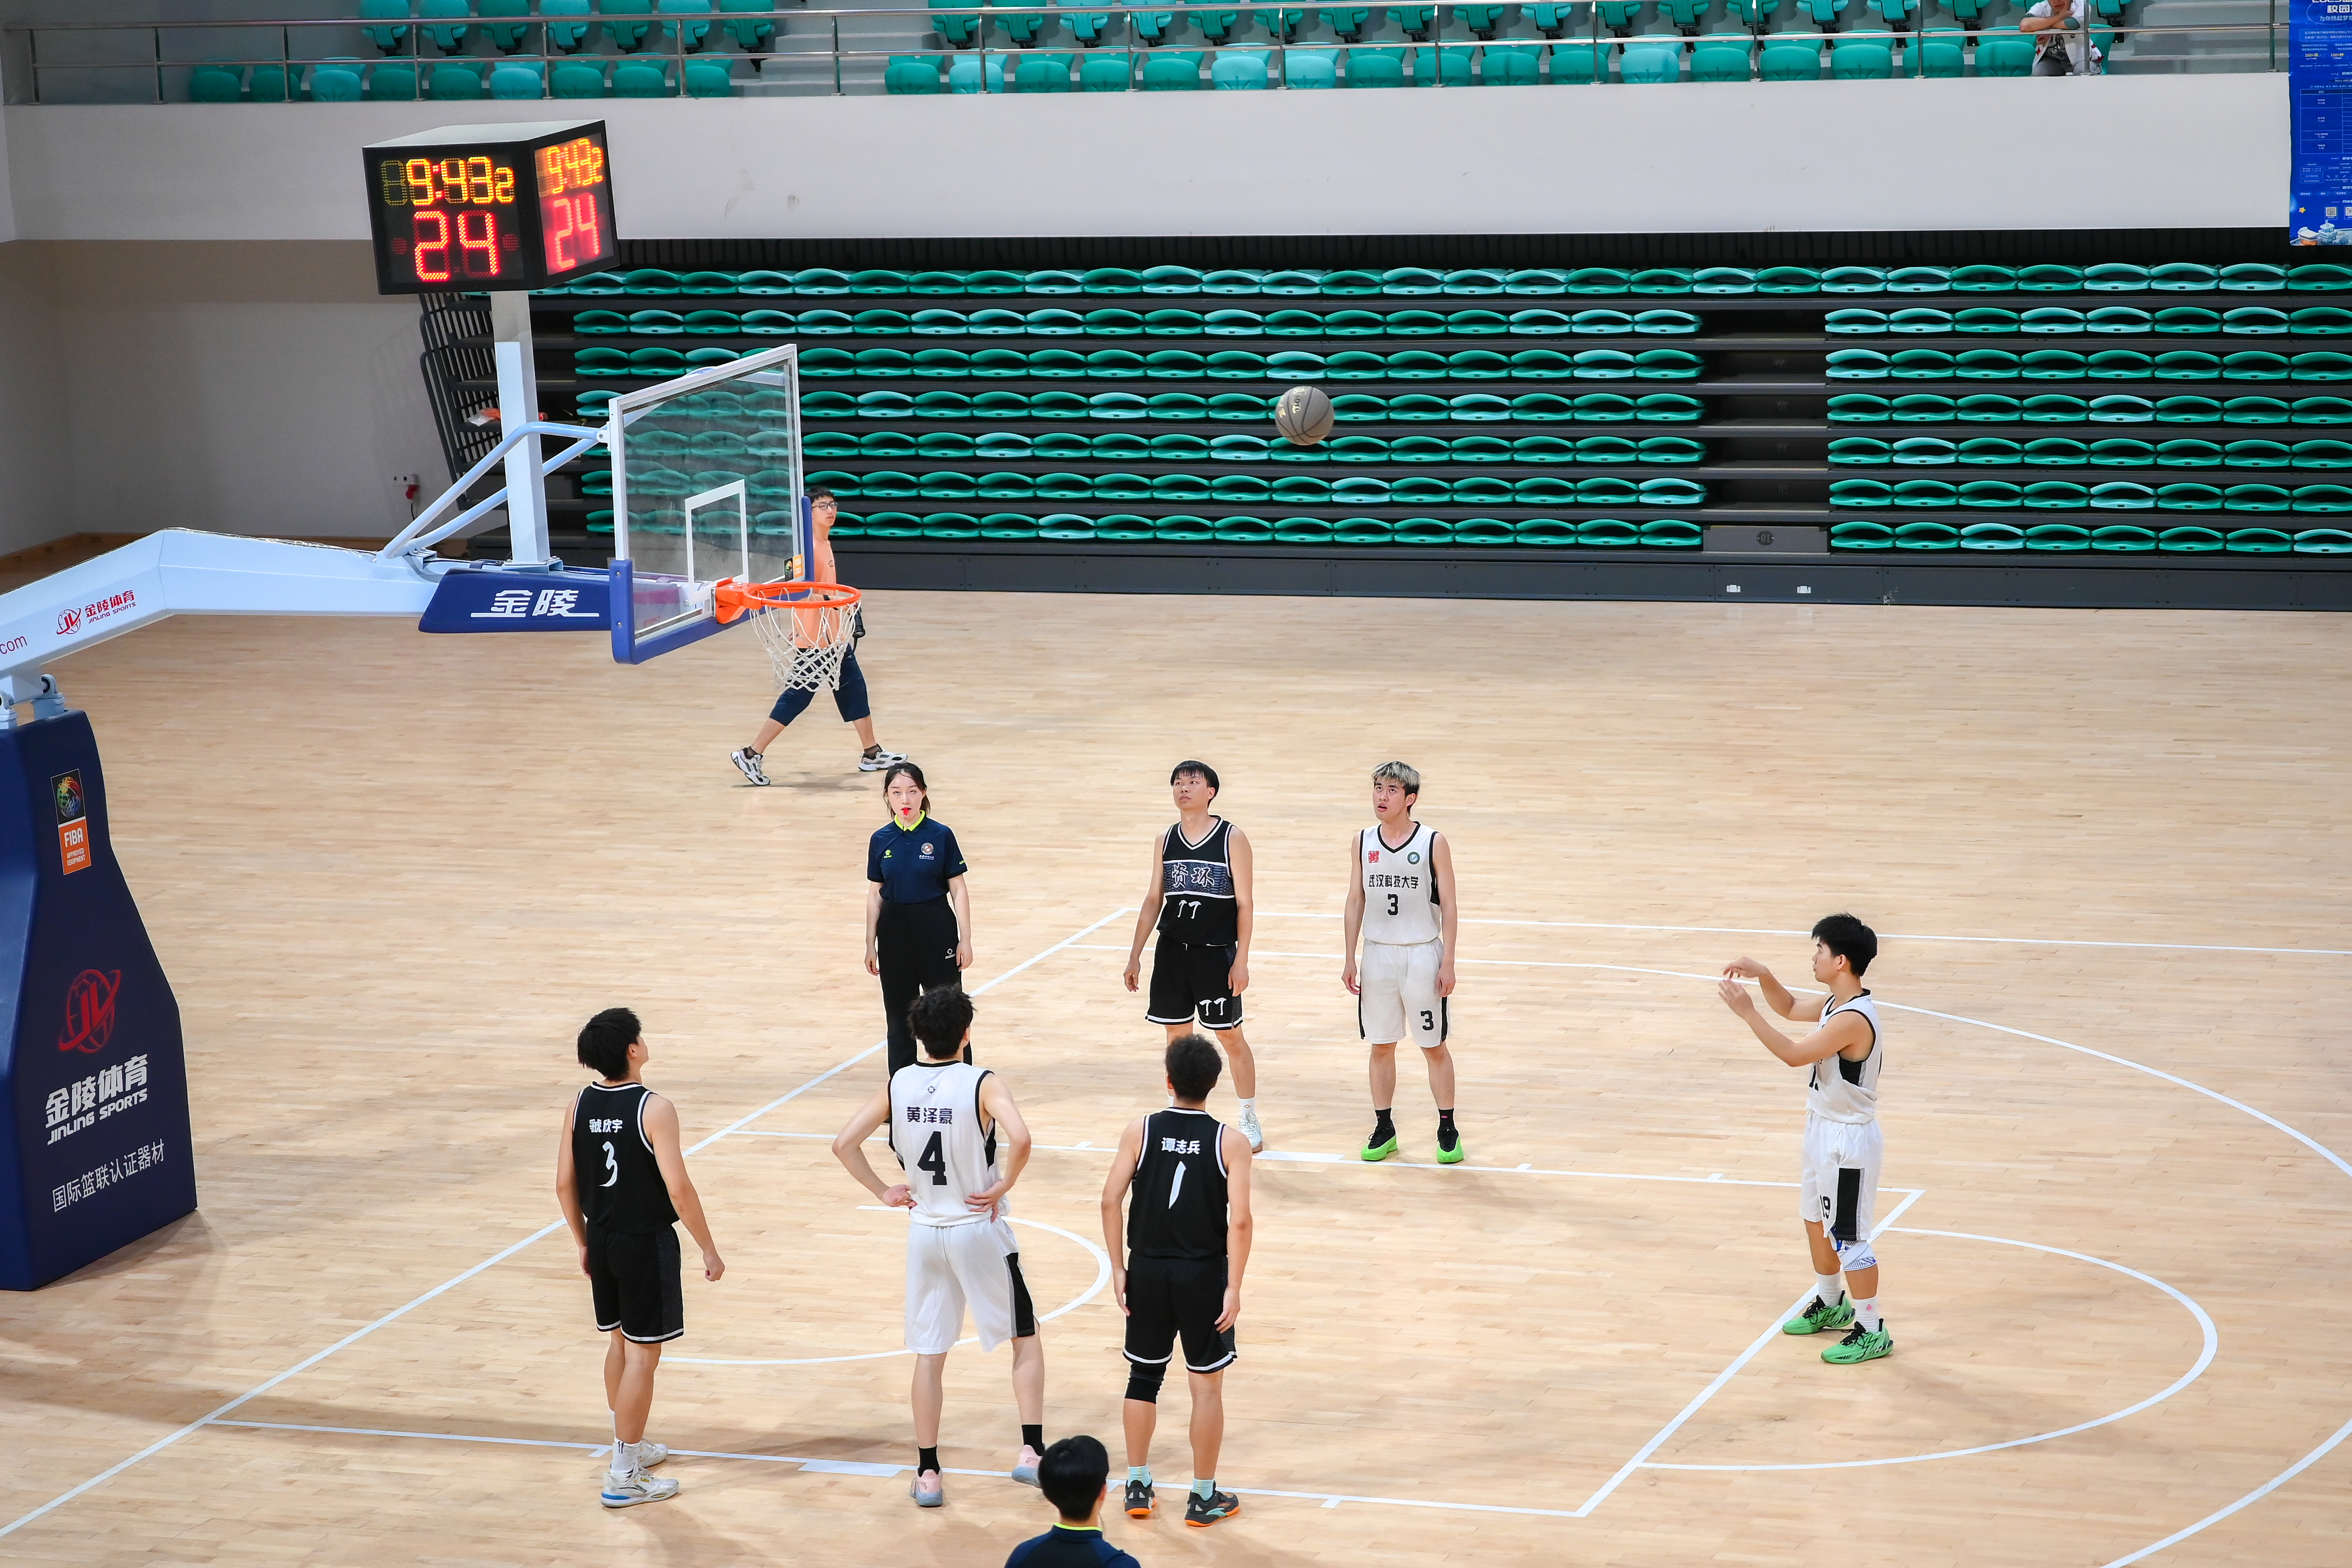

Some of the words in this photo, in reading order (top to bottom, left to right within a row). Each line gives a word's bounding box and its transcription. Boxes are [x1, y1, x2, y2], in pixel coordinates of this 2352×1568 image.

[2327, 4, 2352, 13] 校园
[553, 193, 600, 270] 24
[414, 210, 501, 282] 24
[84, 589, 135, 618] 金陵体育
[88, 611, 111, 624] JINLING
[113, 601, 136, 615] SPORTS
[470, 589, 599, 617] 金陵
[64, 827, 83, 848] FIBA
[66, 848, 84, 859] APPROVED
[67, 854, 85, 866] EQUIPMENT
[1172, 862, 1215, 888] 资环
[1369, 874, 1419, 889] 武汉科技大学
[1387, 894, 1398, 915] 3
[1420, 1010, 1434, 1031] 3
[45, 1053, 148, 1129] 金陵体育
[47, 1111, 95, 1146] JINLING
[99, 1087, 148, 1120] SPORTS
[906, 1106, 953, 1124] 黄泽豪
[916, 1131, 947, 1185] 4
[1161, 1137, 1200, 1155] 谭志兵
[53, 1138, 165, 1213] 国际篮联认证器材
[598, 1141, 618, 1187] 3
[1169, 1161, 1186, 1210] 1
